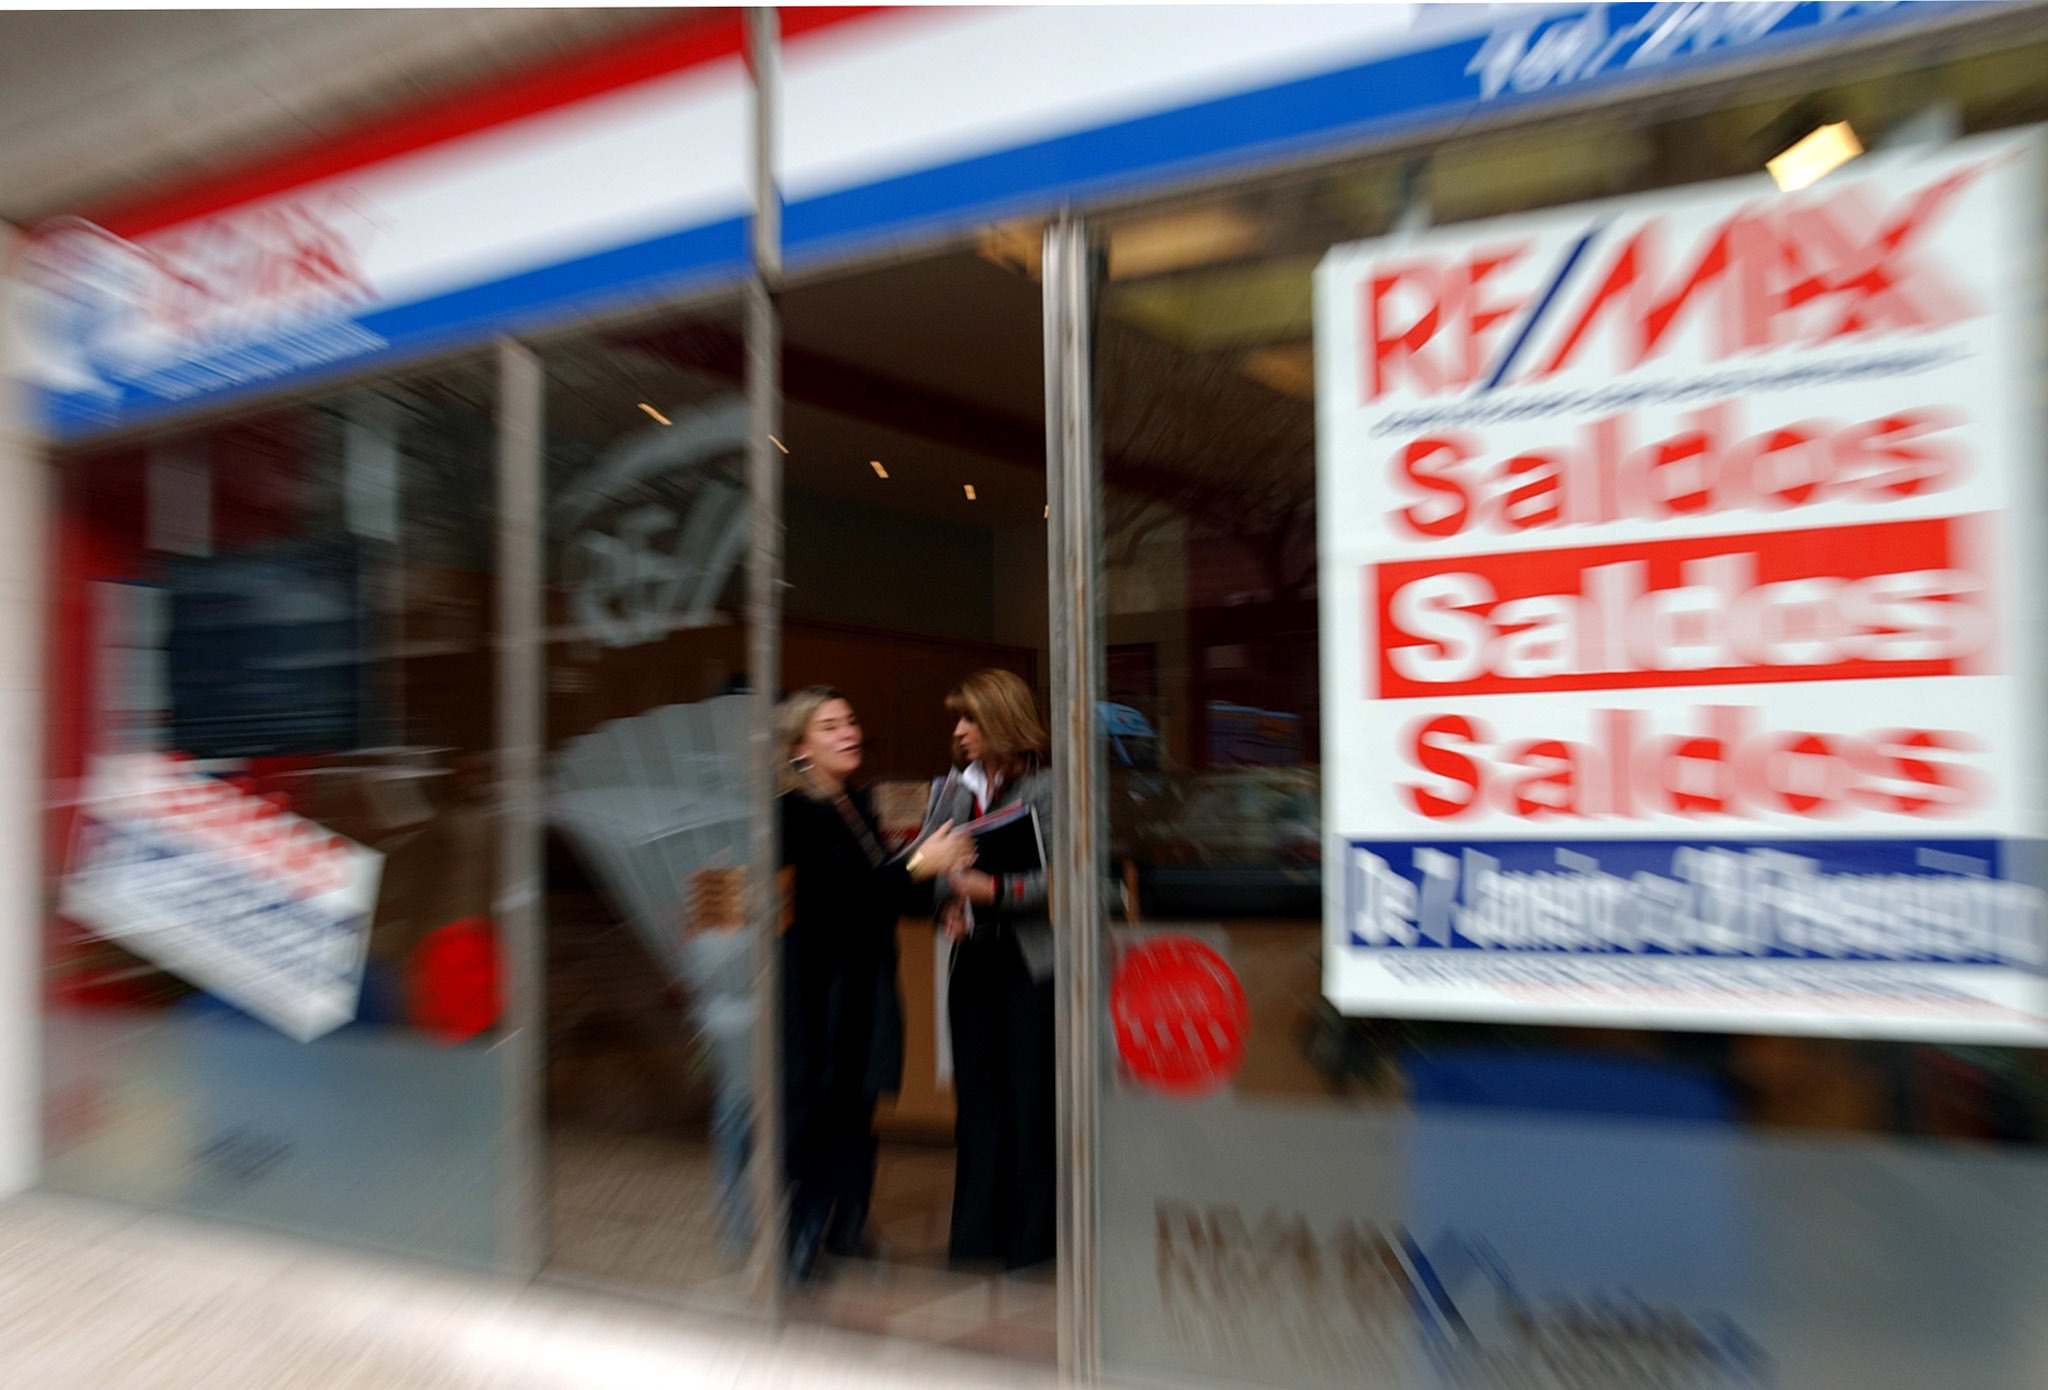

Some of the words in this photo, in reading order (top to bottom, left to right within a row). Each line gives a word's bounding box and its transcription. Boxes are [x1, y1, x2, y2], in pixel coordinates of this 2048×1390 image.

[1360, 155, 2020, 406] RE/MAX
[1388, 403, 1972, 540] Saldos
[1388, 553, 1990, 682] Saldos
[1396, 706, 1992, 820] Saldos
